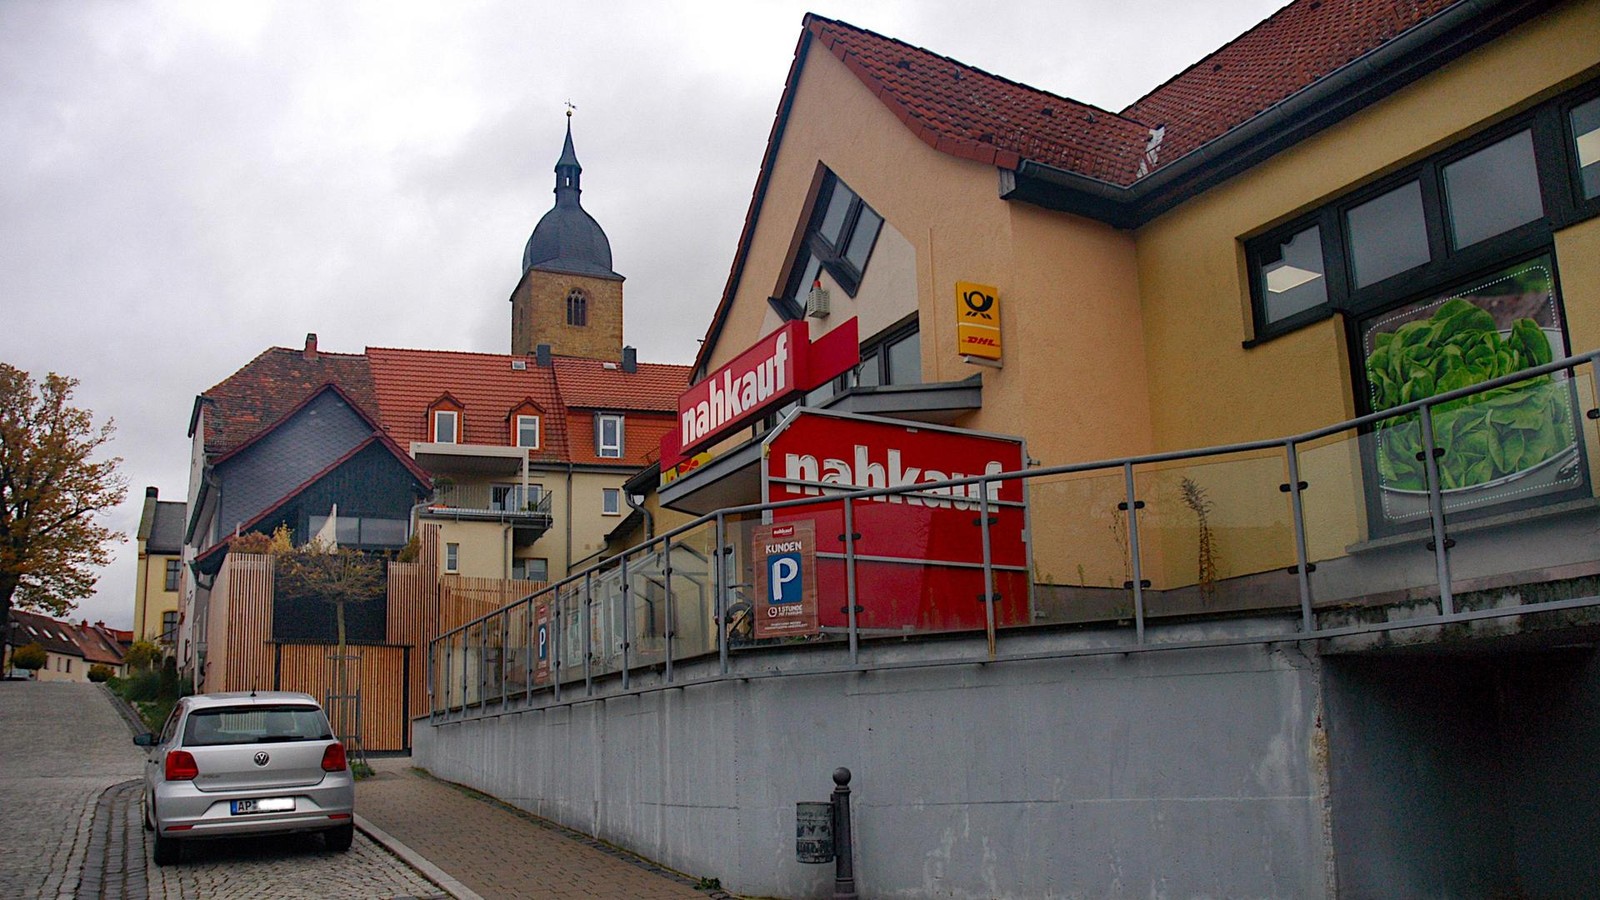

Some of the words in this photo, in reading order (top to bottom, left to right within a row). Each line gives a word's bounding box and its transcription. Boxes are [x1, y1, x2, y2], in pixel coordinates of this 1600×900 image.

[967, 336, 995, 347] DHL
[682, 332, 788, 447] nahkauf
[785, 445, 1003, 513] nahkauf
[765, 541, 802, 554] KUNDEN
[772, 557, 798, 601] P
[539, 627, 546, 658] P
[238, 801, 252, 812] AP
